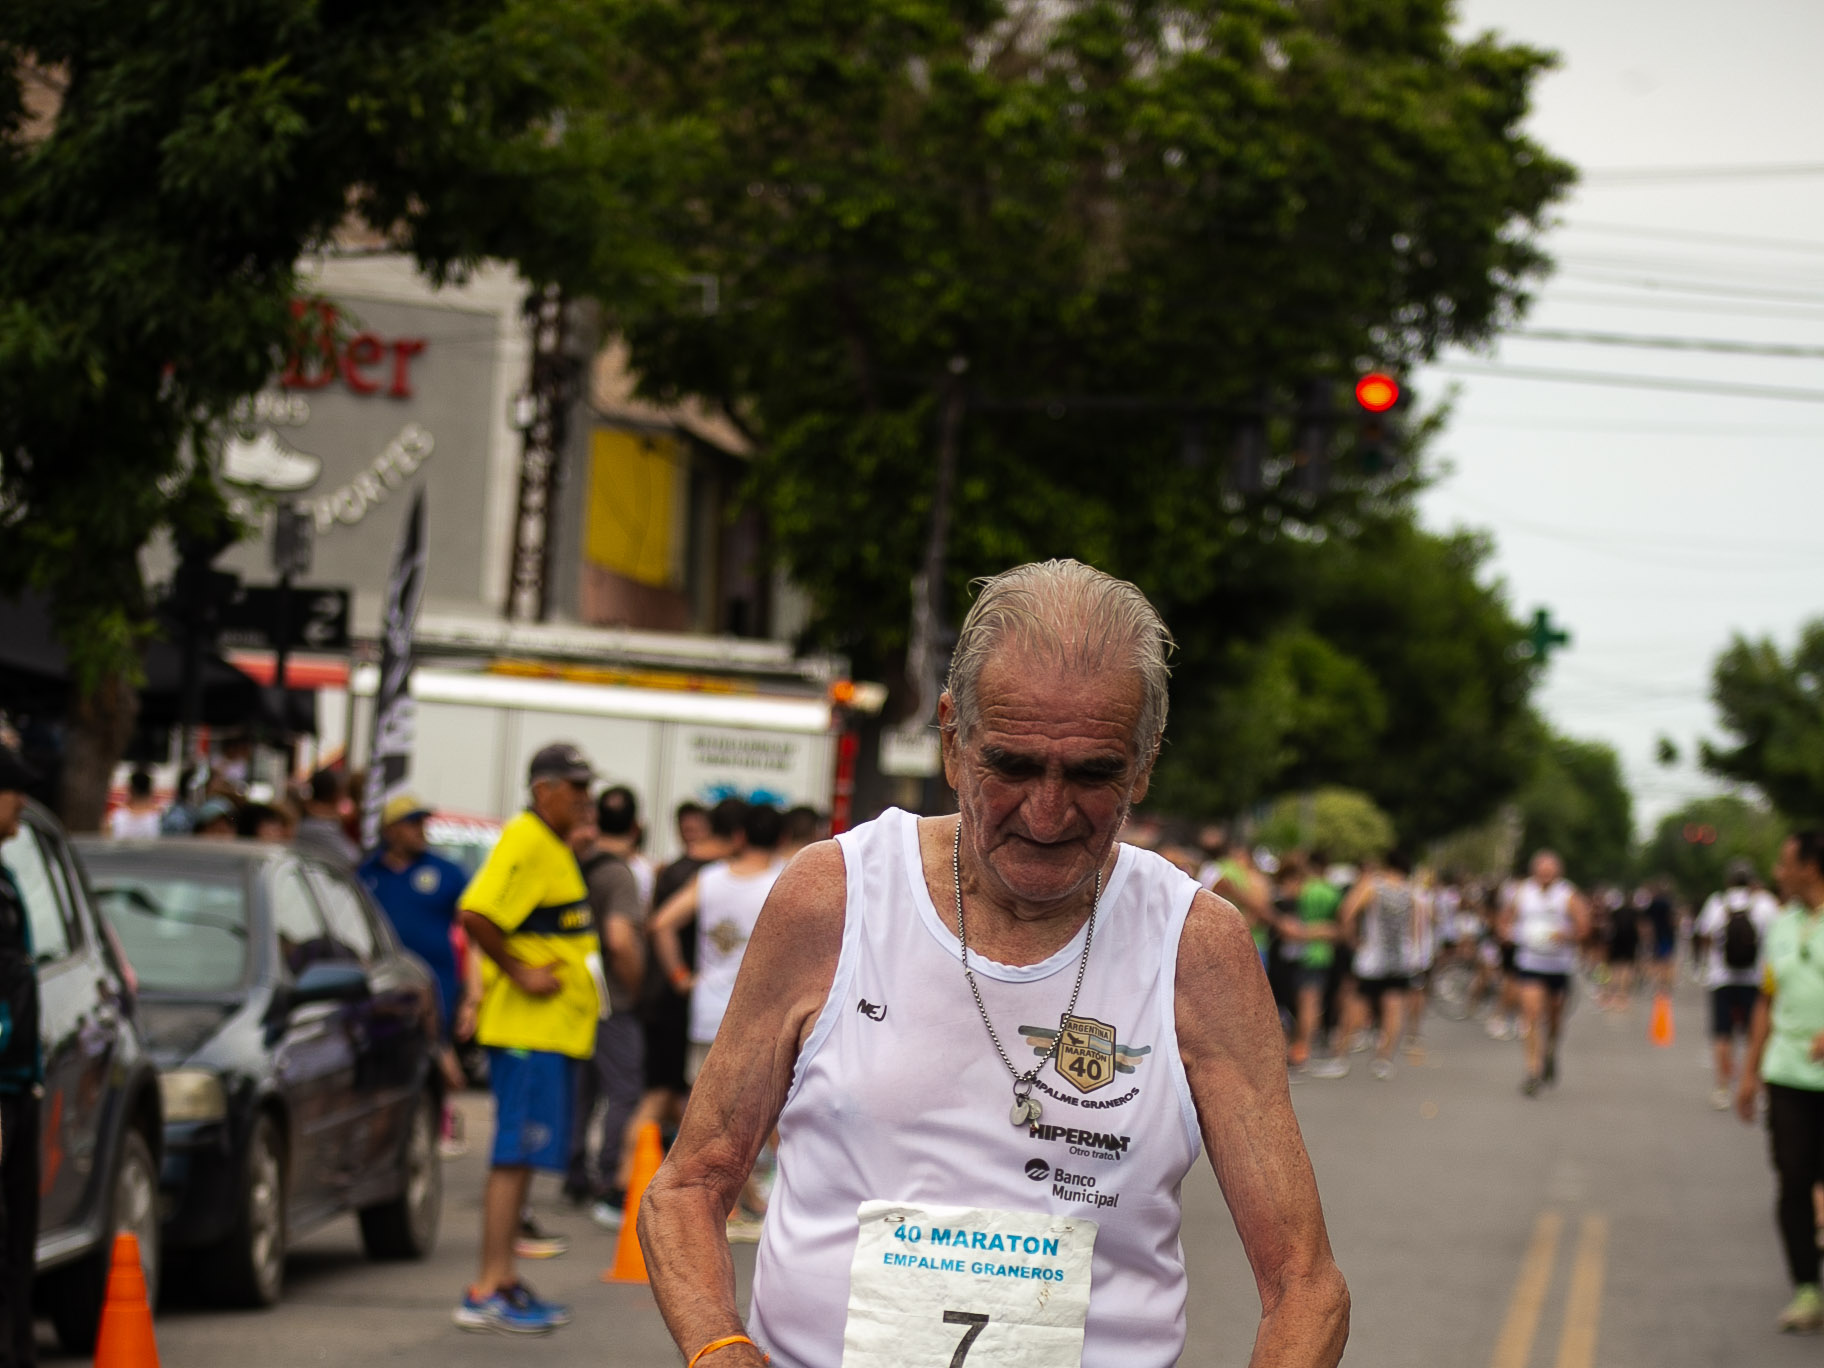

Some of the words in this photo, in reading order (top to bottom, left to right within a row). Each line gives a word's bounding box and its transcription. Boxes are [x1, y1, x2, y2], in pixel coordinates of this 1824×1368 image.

[1067, 1020, 1109, 1040] ARGENTINA
[1068, 1056, 1102, 1080] 40
[1080, 1086, 1140, 1110] GRANEROS
[1069, 1145, 1090, 1157] Otro
[1054, 1167, 1096, 1188] Banco
[1052, 1183, 1119, 1209] Municipal
[894, 1223, 922, 1243] 40
[930, 1227, 1060, 1257] MARATON
[883, 1252, 965, 1273] EMPALME
[971, 1261, 1065, 1282] GRANEROS
